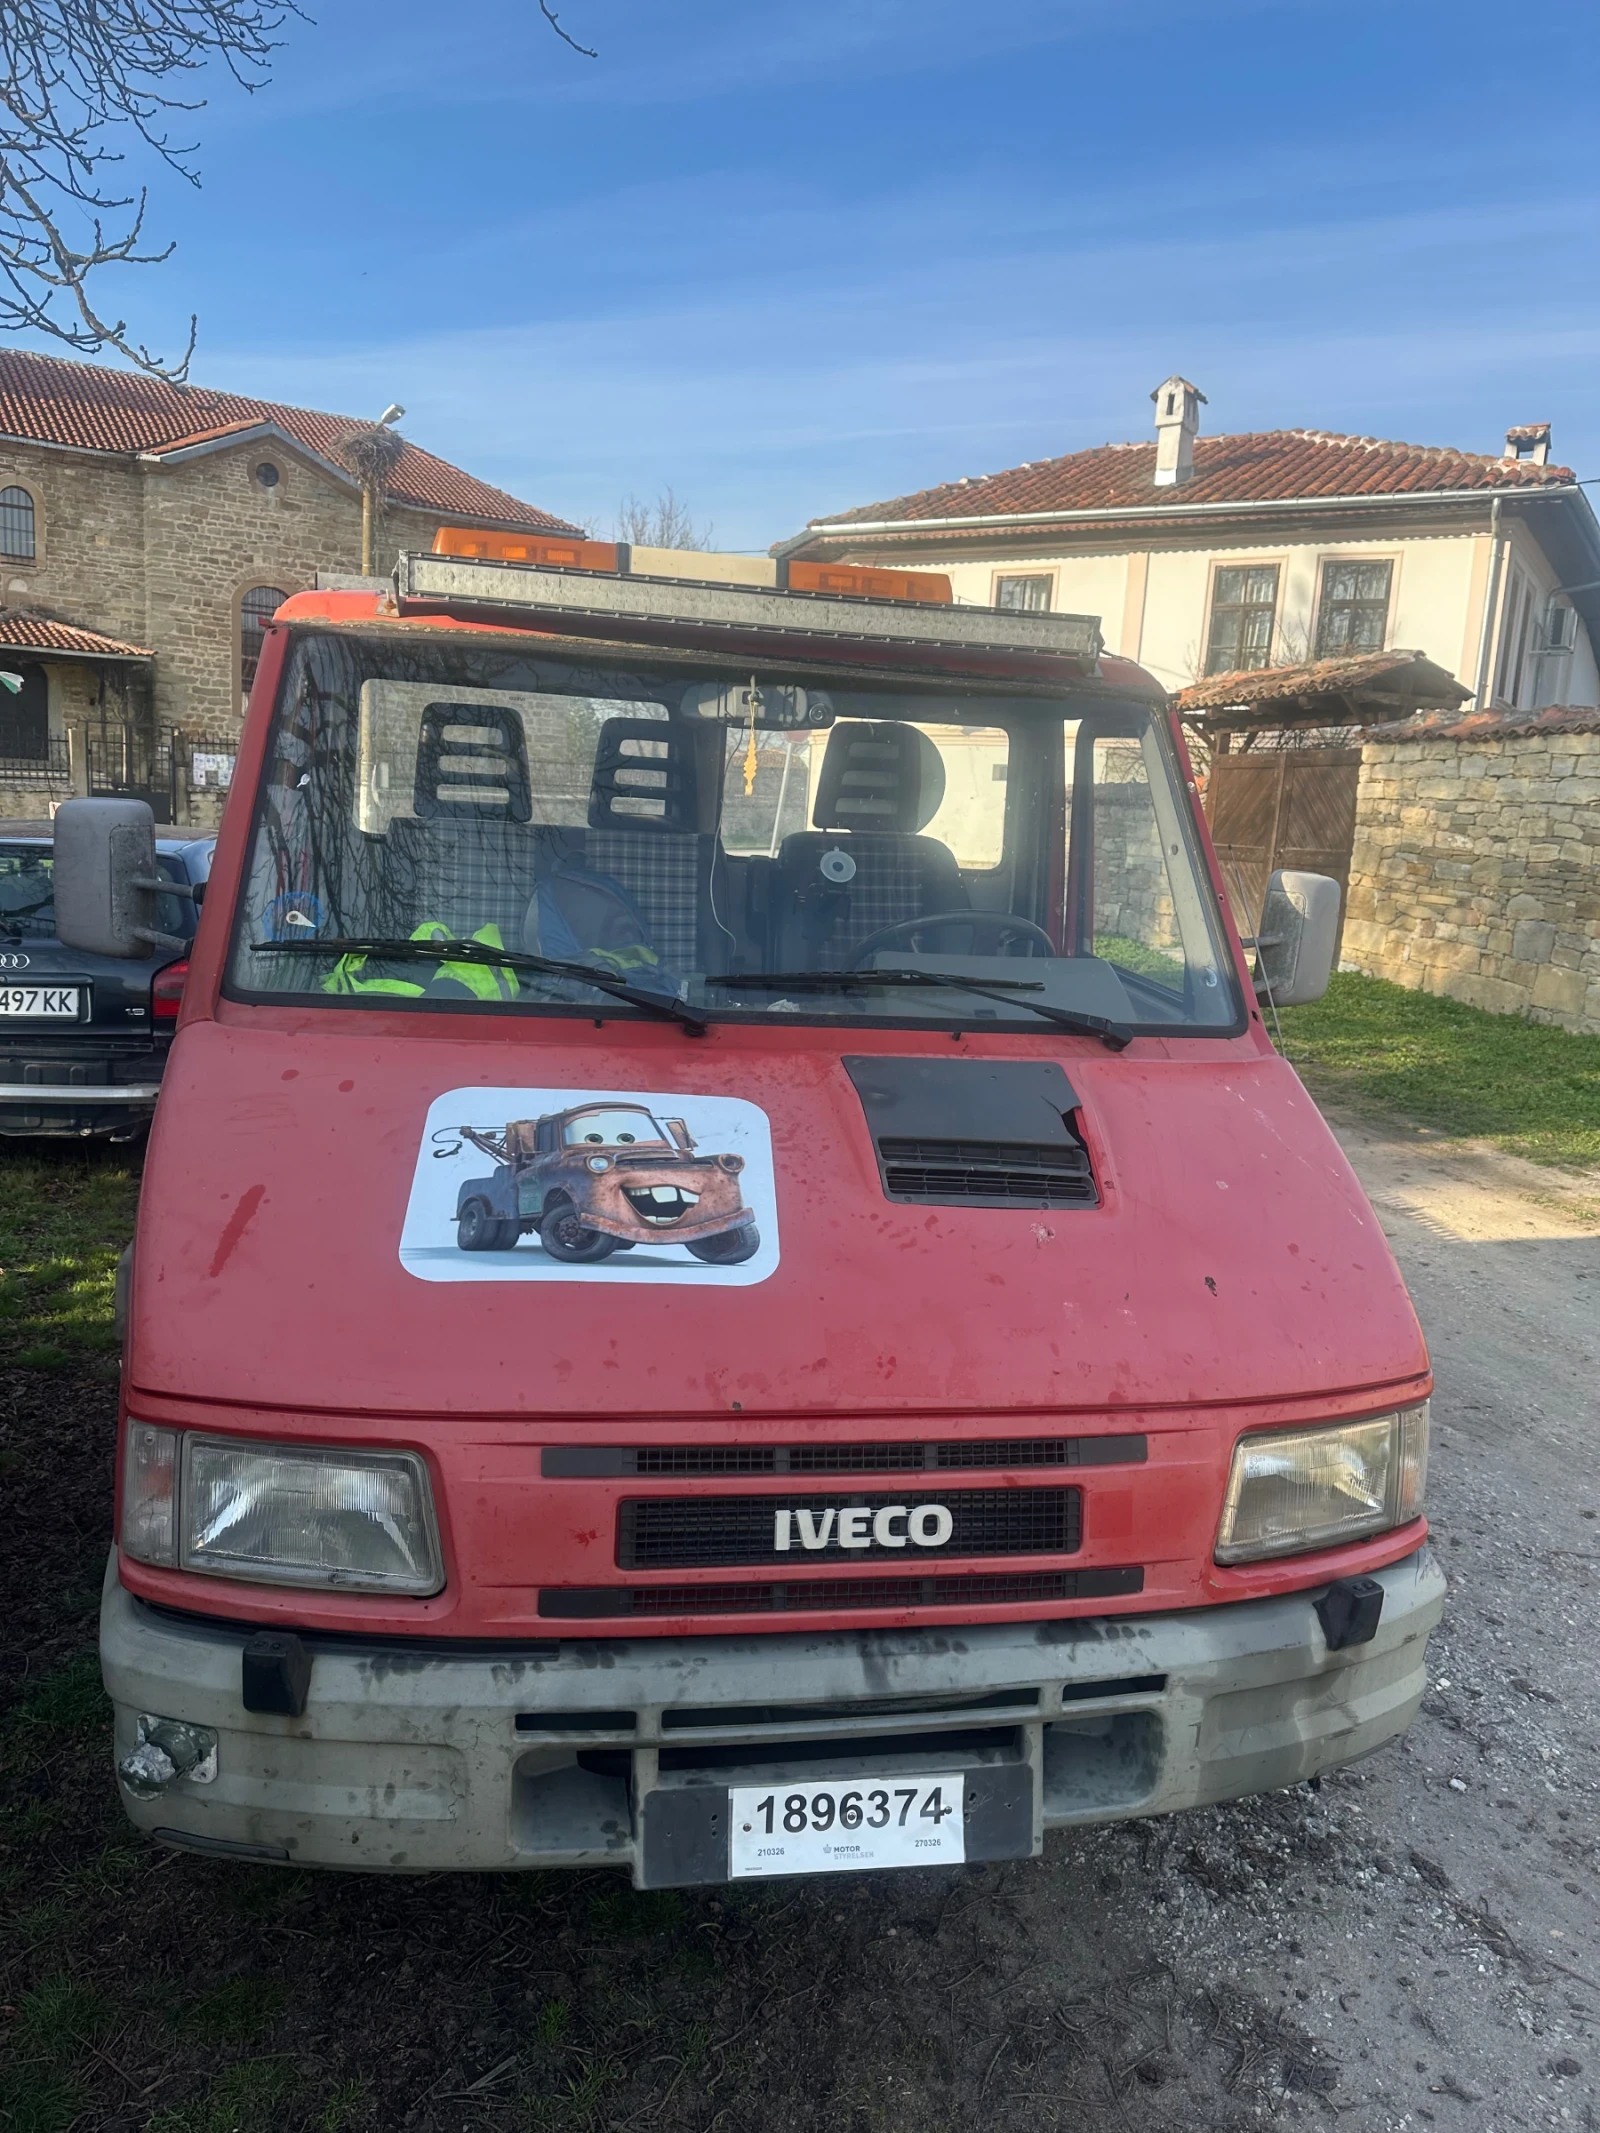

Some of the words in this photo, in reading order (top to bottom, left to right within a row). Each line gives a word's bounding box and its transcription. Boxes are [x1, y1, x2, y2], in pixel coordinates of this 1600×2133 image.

[43, 991, 72, 1012] KK
[775, 1504, 953, 1550] IVECO
[757, 1787, 944, 1834] 1896374
[915, 1839, 942, 1847] 270326
[757, 1848, 785, 1857] 210326
[834, 1851, 874, 1860] STYRELSEN
